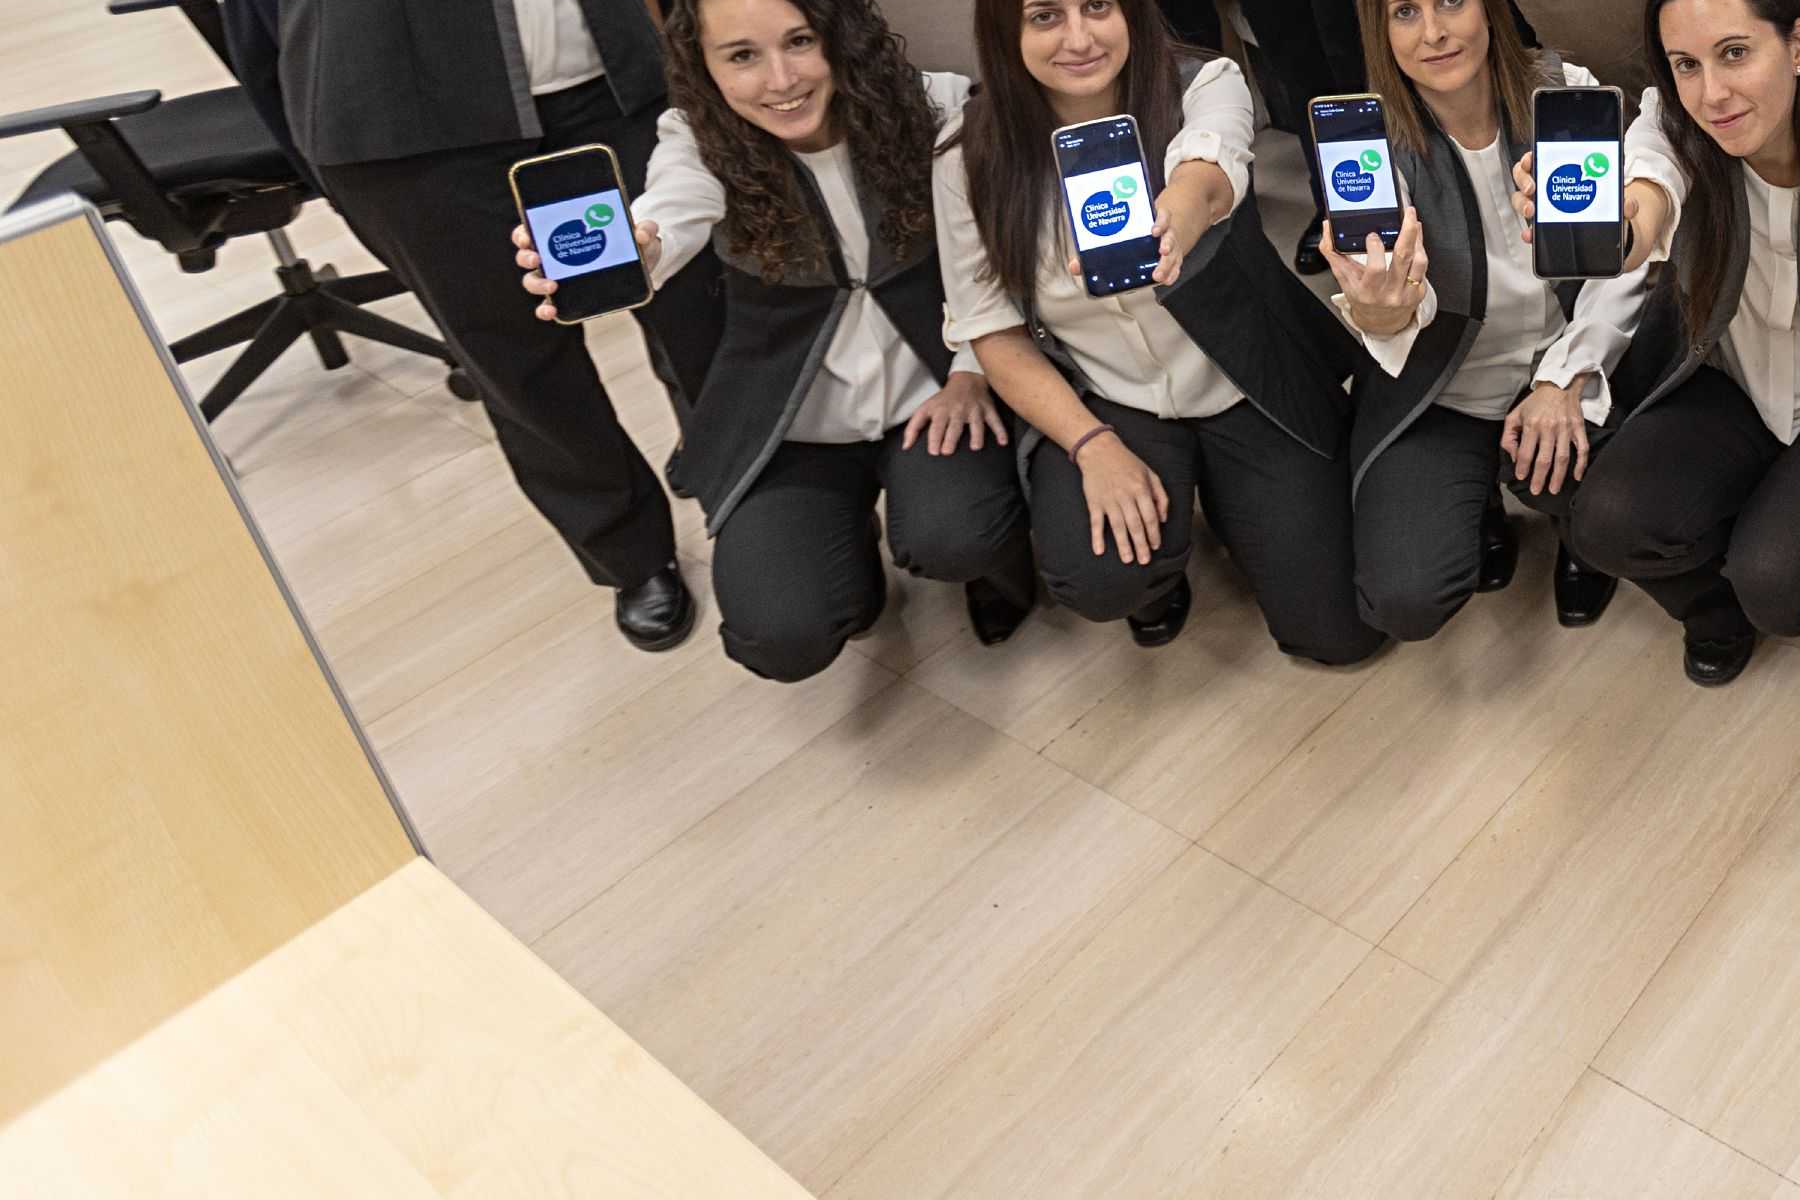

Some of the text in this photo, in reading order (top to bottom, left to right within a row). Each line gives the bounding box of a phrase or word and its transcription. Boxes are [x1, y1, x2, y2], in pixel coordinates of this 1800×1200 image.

[1337, 176, 1371, 185] Universidad
[1347, 184, 1370, 192] Navarra
[1552, 184, 1593, 192] Universidad
[1087, 206, 1126, 221] Universidad
[1088, 215, 1126, 229] de Navarra
[554, 234, 602, 251] Universidad
[569, 243, 601, 255] Navarra
